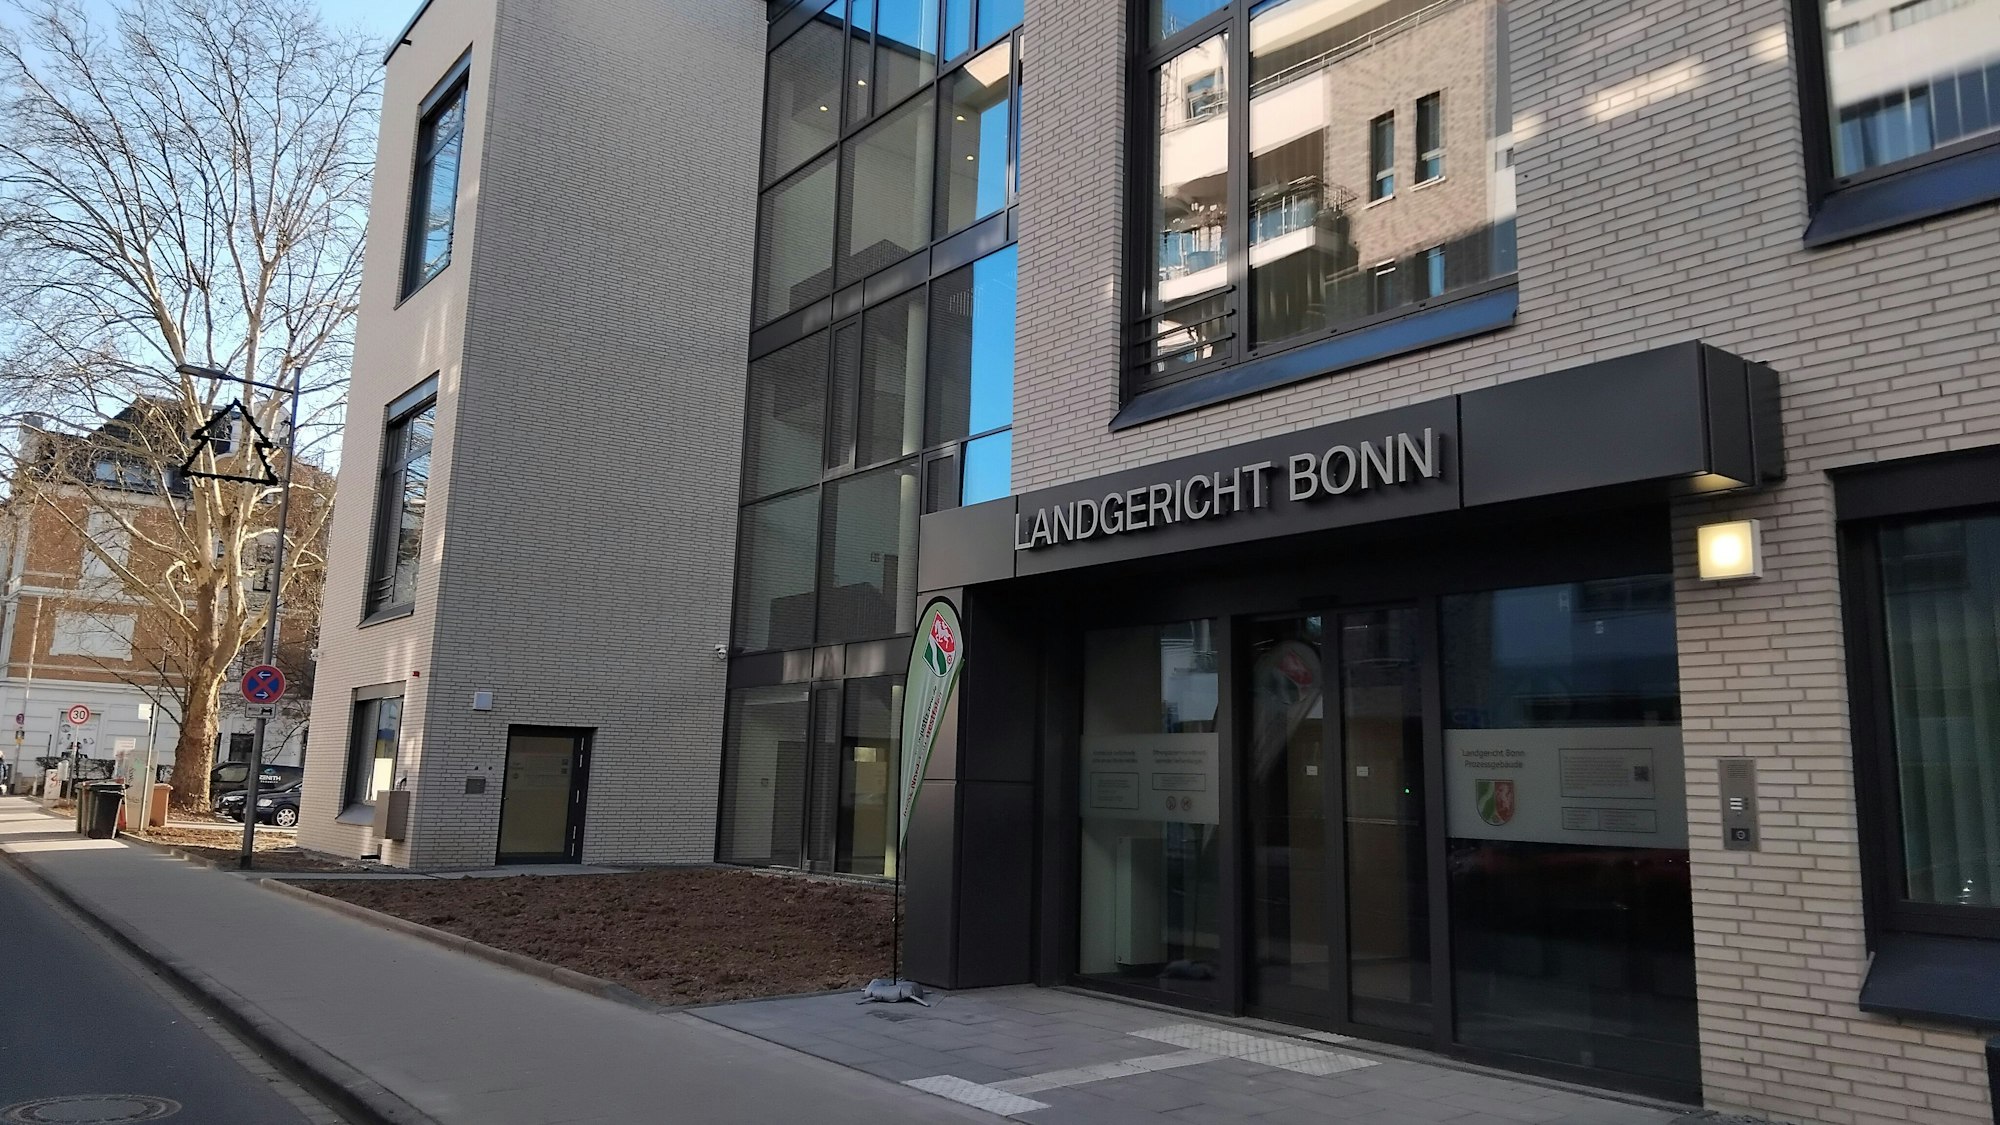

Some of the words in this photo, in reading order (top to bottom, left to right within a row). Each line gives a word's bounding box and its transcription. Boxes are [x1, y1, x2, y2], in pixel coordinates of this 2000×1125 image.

[1014, 460, 1275, 551] LANDGERICHT
[1289, 427, 1436, 502] BONN
[72, 710, 86, 720] 30
[1462, 748, 1504, 759] Landgericht
